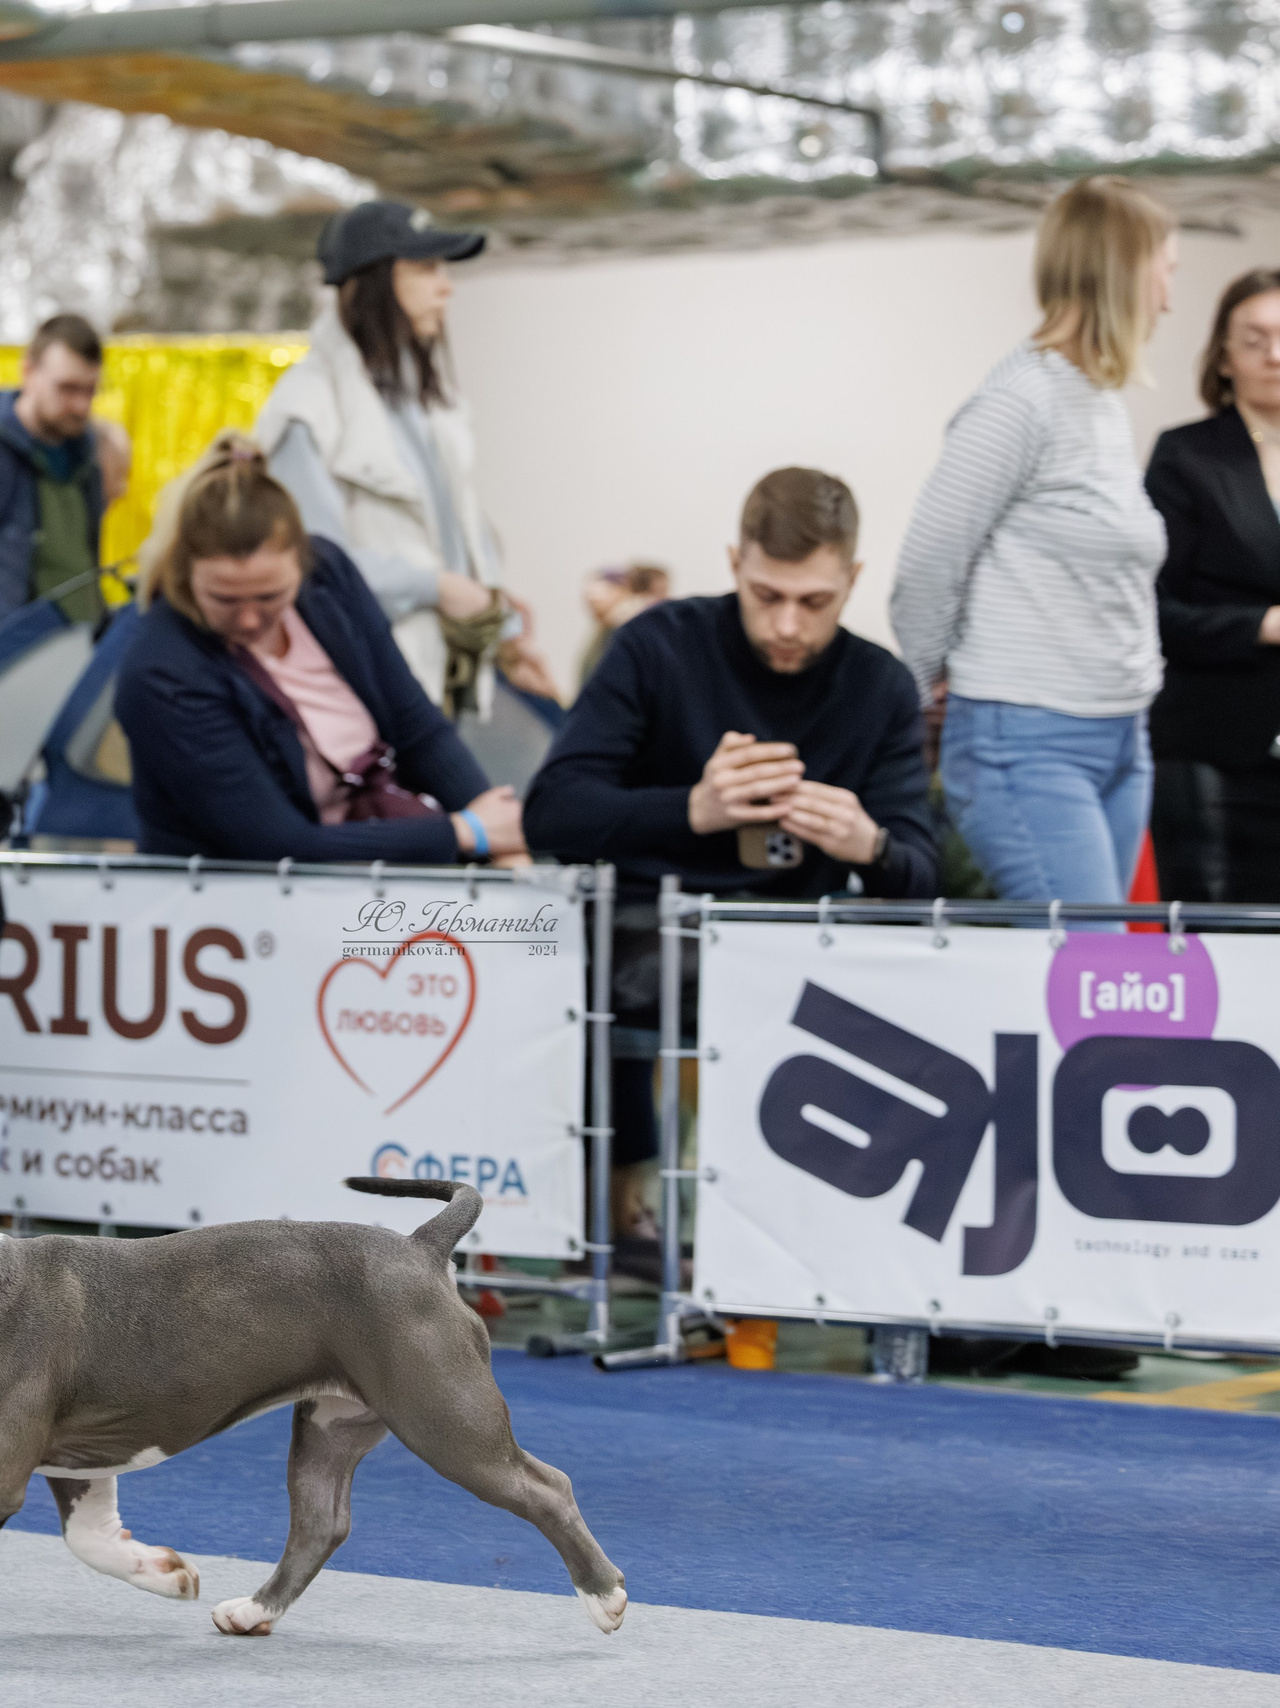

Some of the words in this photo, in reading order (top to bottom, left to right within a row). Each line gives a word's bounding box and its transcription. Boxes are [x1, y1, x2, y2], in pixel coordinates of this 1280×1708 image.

[407, 974, 459, 998] ЭТО
[336, 1008, 447, 1037] ЛЮБОВЬ
[22, 1148, 42, 1175] и
[54, 1146, 161, 1185] собак
[1182, 1243, 1211, 1258] and
